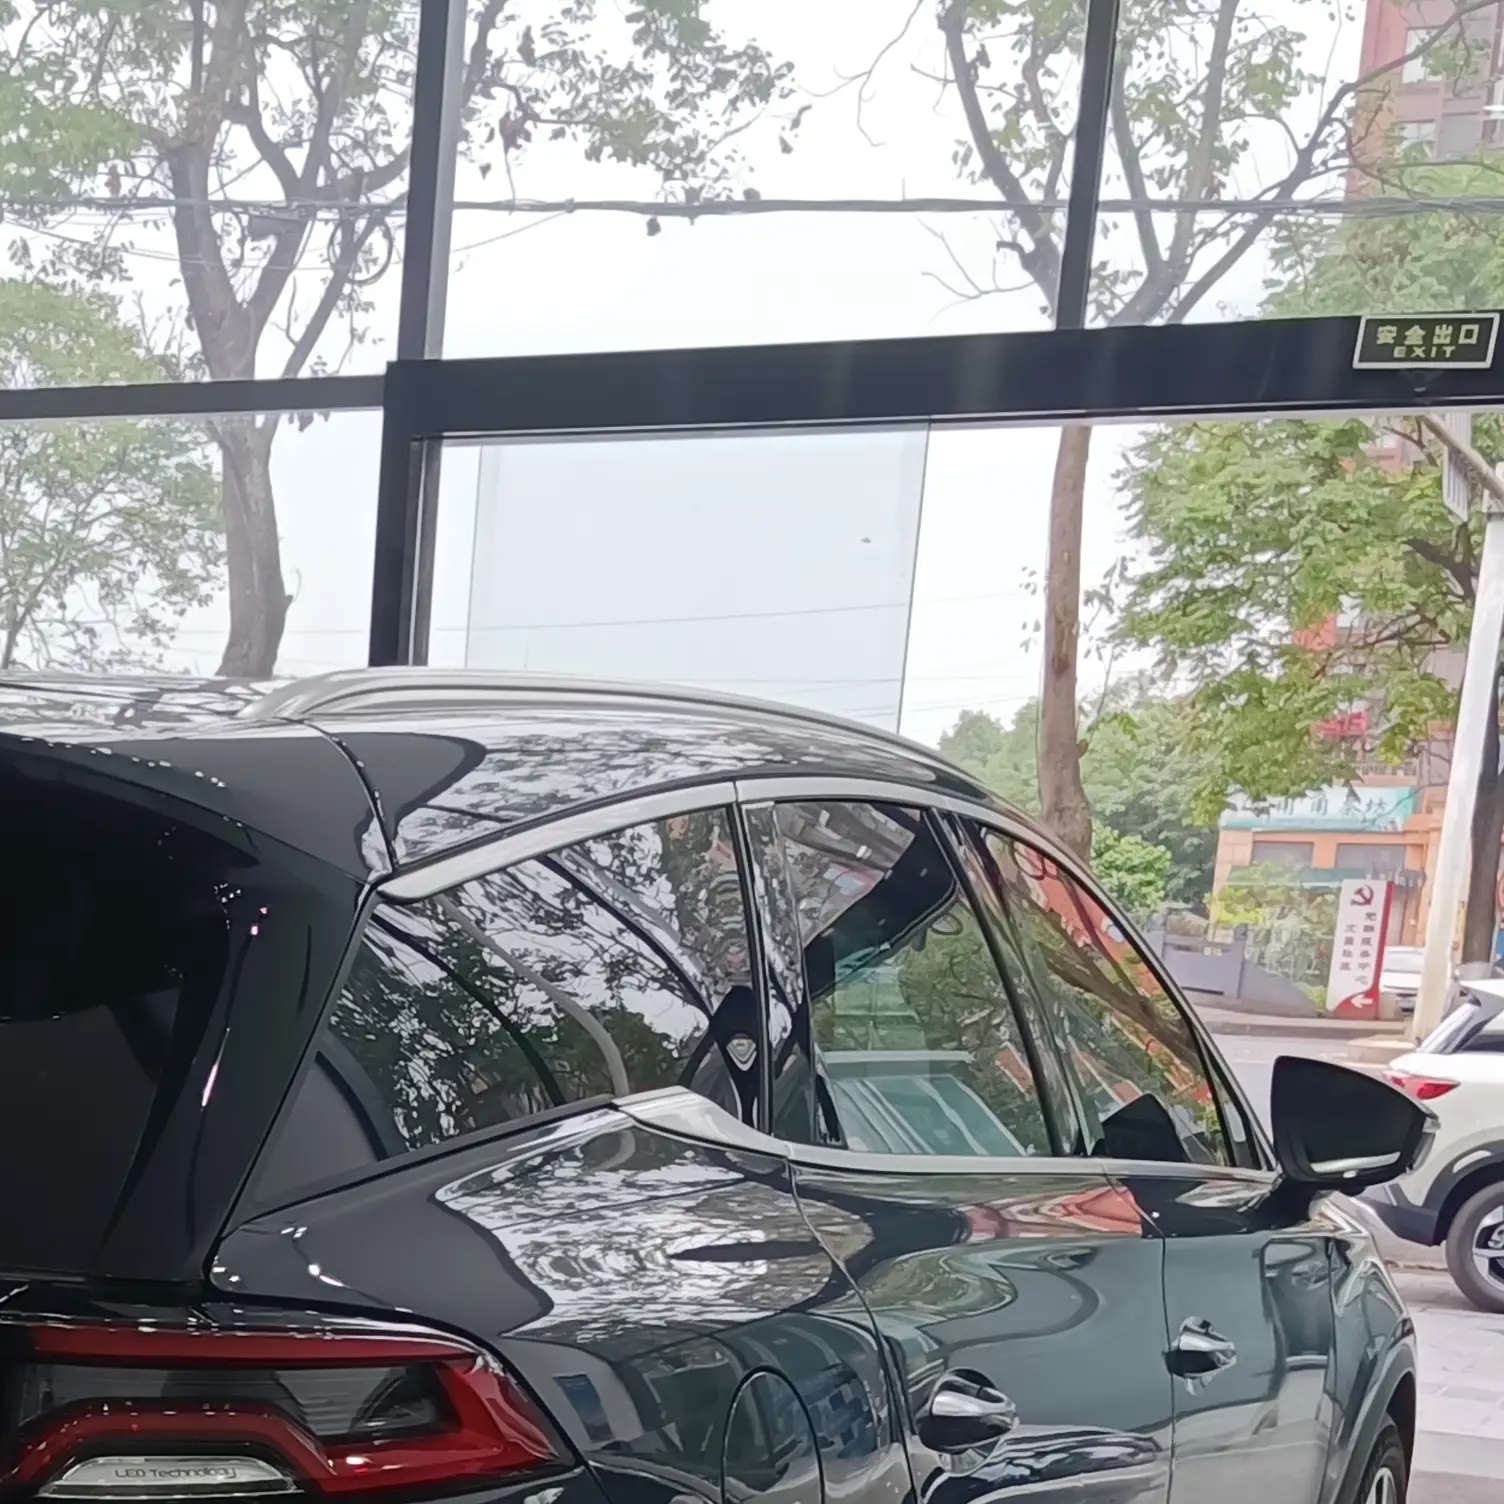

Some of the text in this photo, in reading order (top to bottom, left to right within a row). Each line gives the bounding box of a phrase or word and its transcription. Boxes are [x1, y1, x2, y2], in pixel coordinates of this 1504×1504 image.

[1376, 324, 1479, 345] 安全出口
[1393, 346, 1456, 358] EXIT
[114, 1467, 238, 1479] LED Technology
